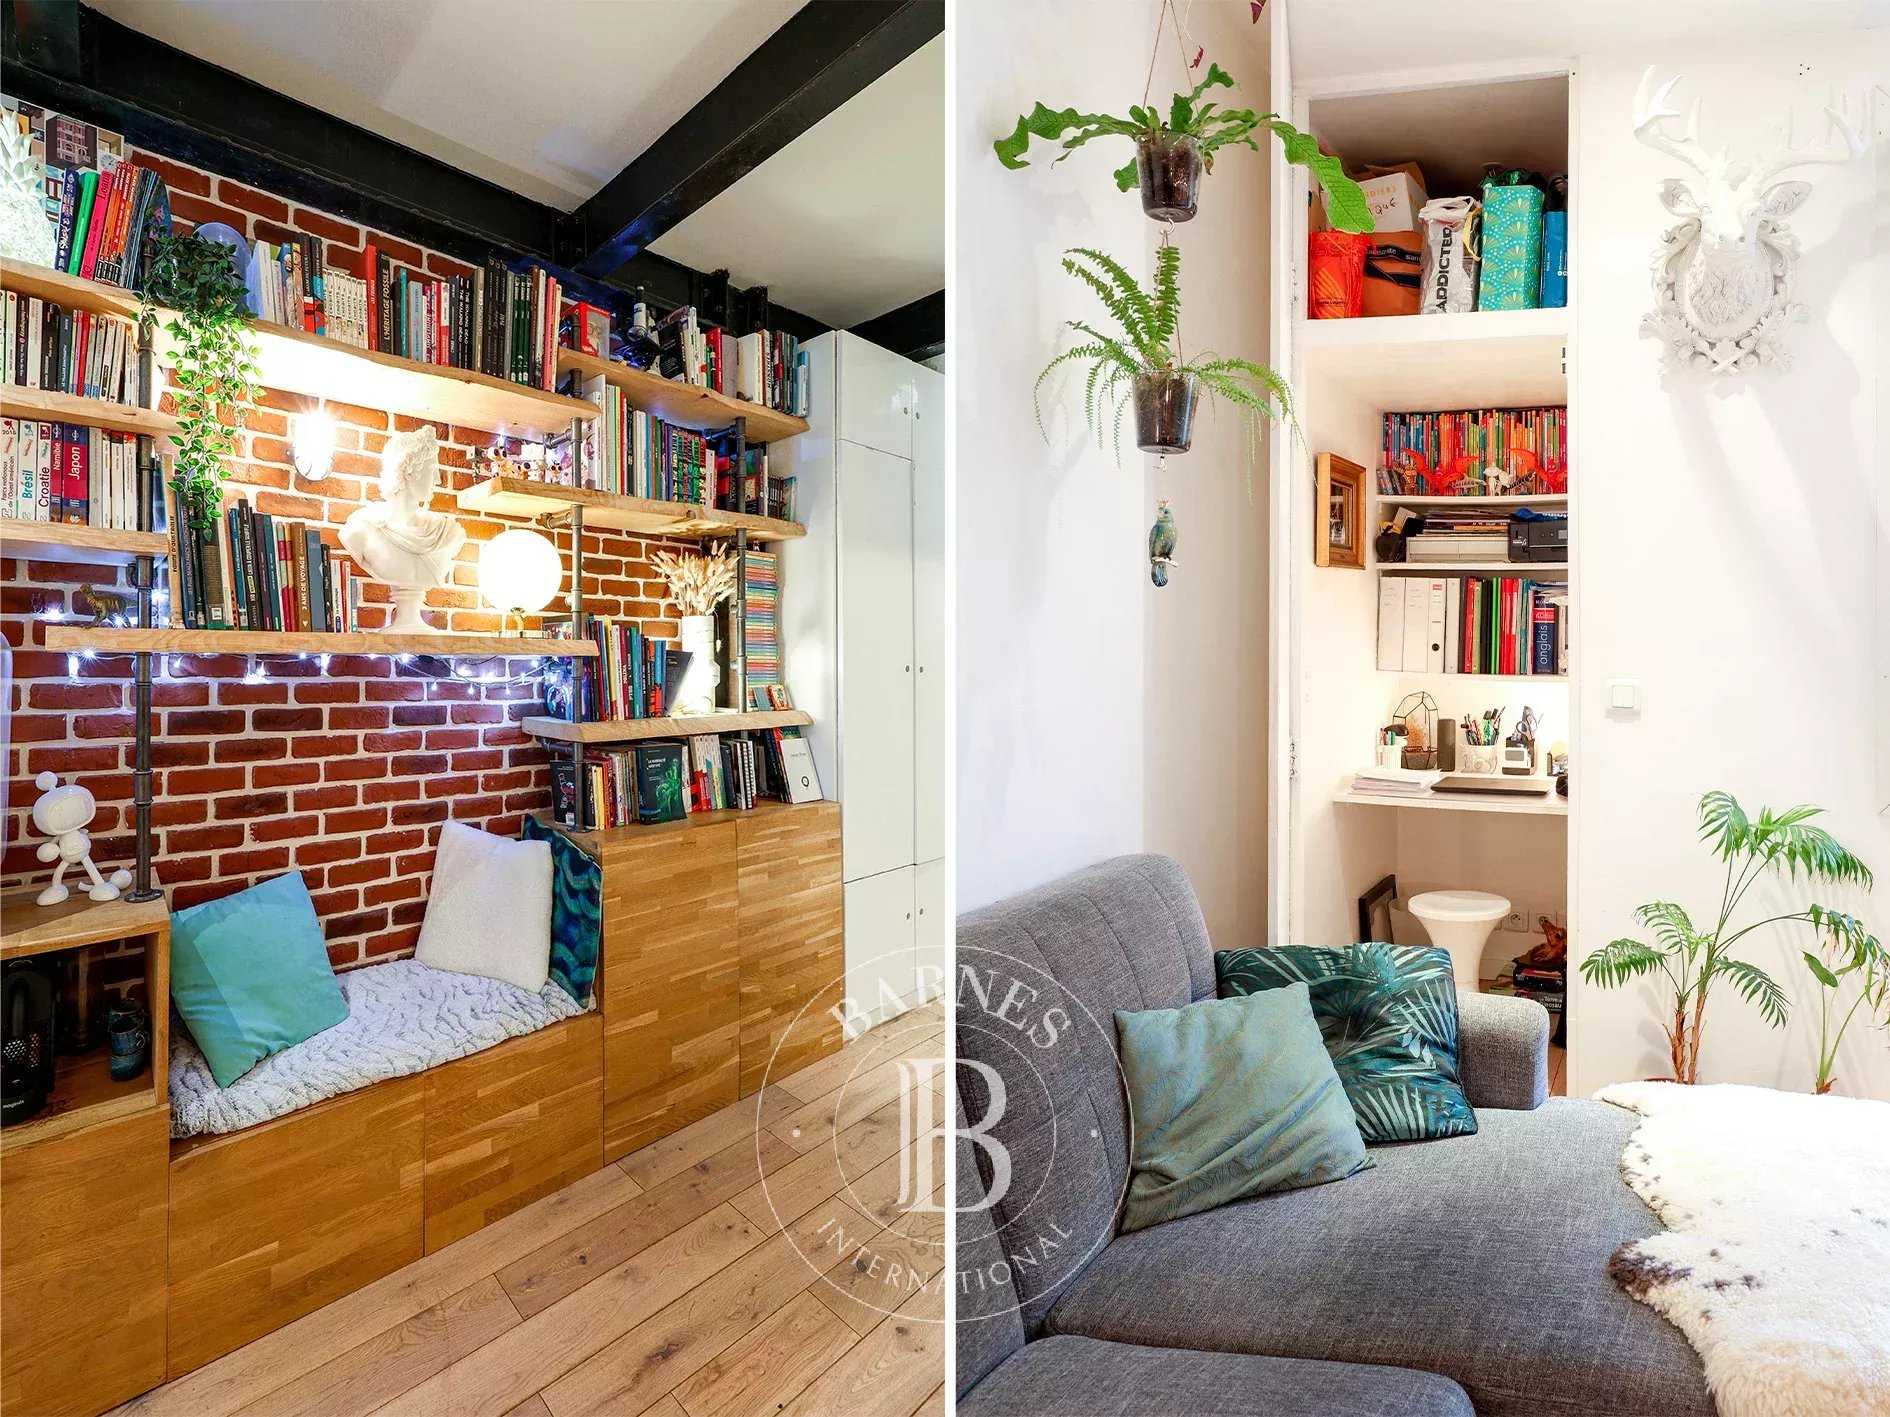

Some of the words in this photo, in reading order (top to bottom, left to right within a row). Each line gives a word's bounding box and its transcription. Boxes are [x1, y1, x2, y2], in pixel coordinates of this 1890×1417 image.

[1436, 226, 1453, 314] ADDICTED
[53, 441, 62, 471] Namibie
[68, 447, 83, 480] Japon
[20, 469, 34, 498] Brésil
[38, 466, 50, 507] Croatie
[299, 556, 307, 582] VOYAGE
